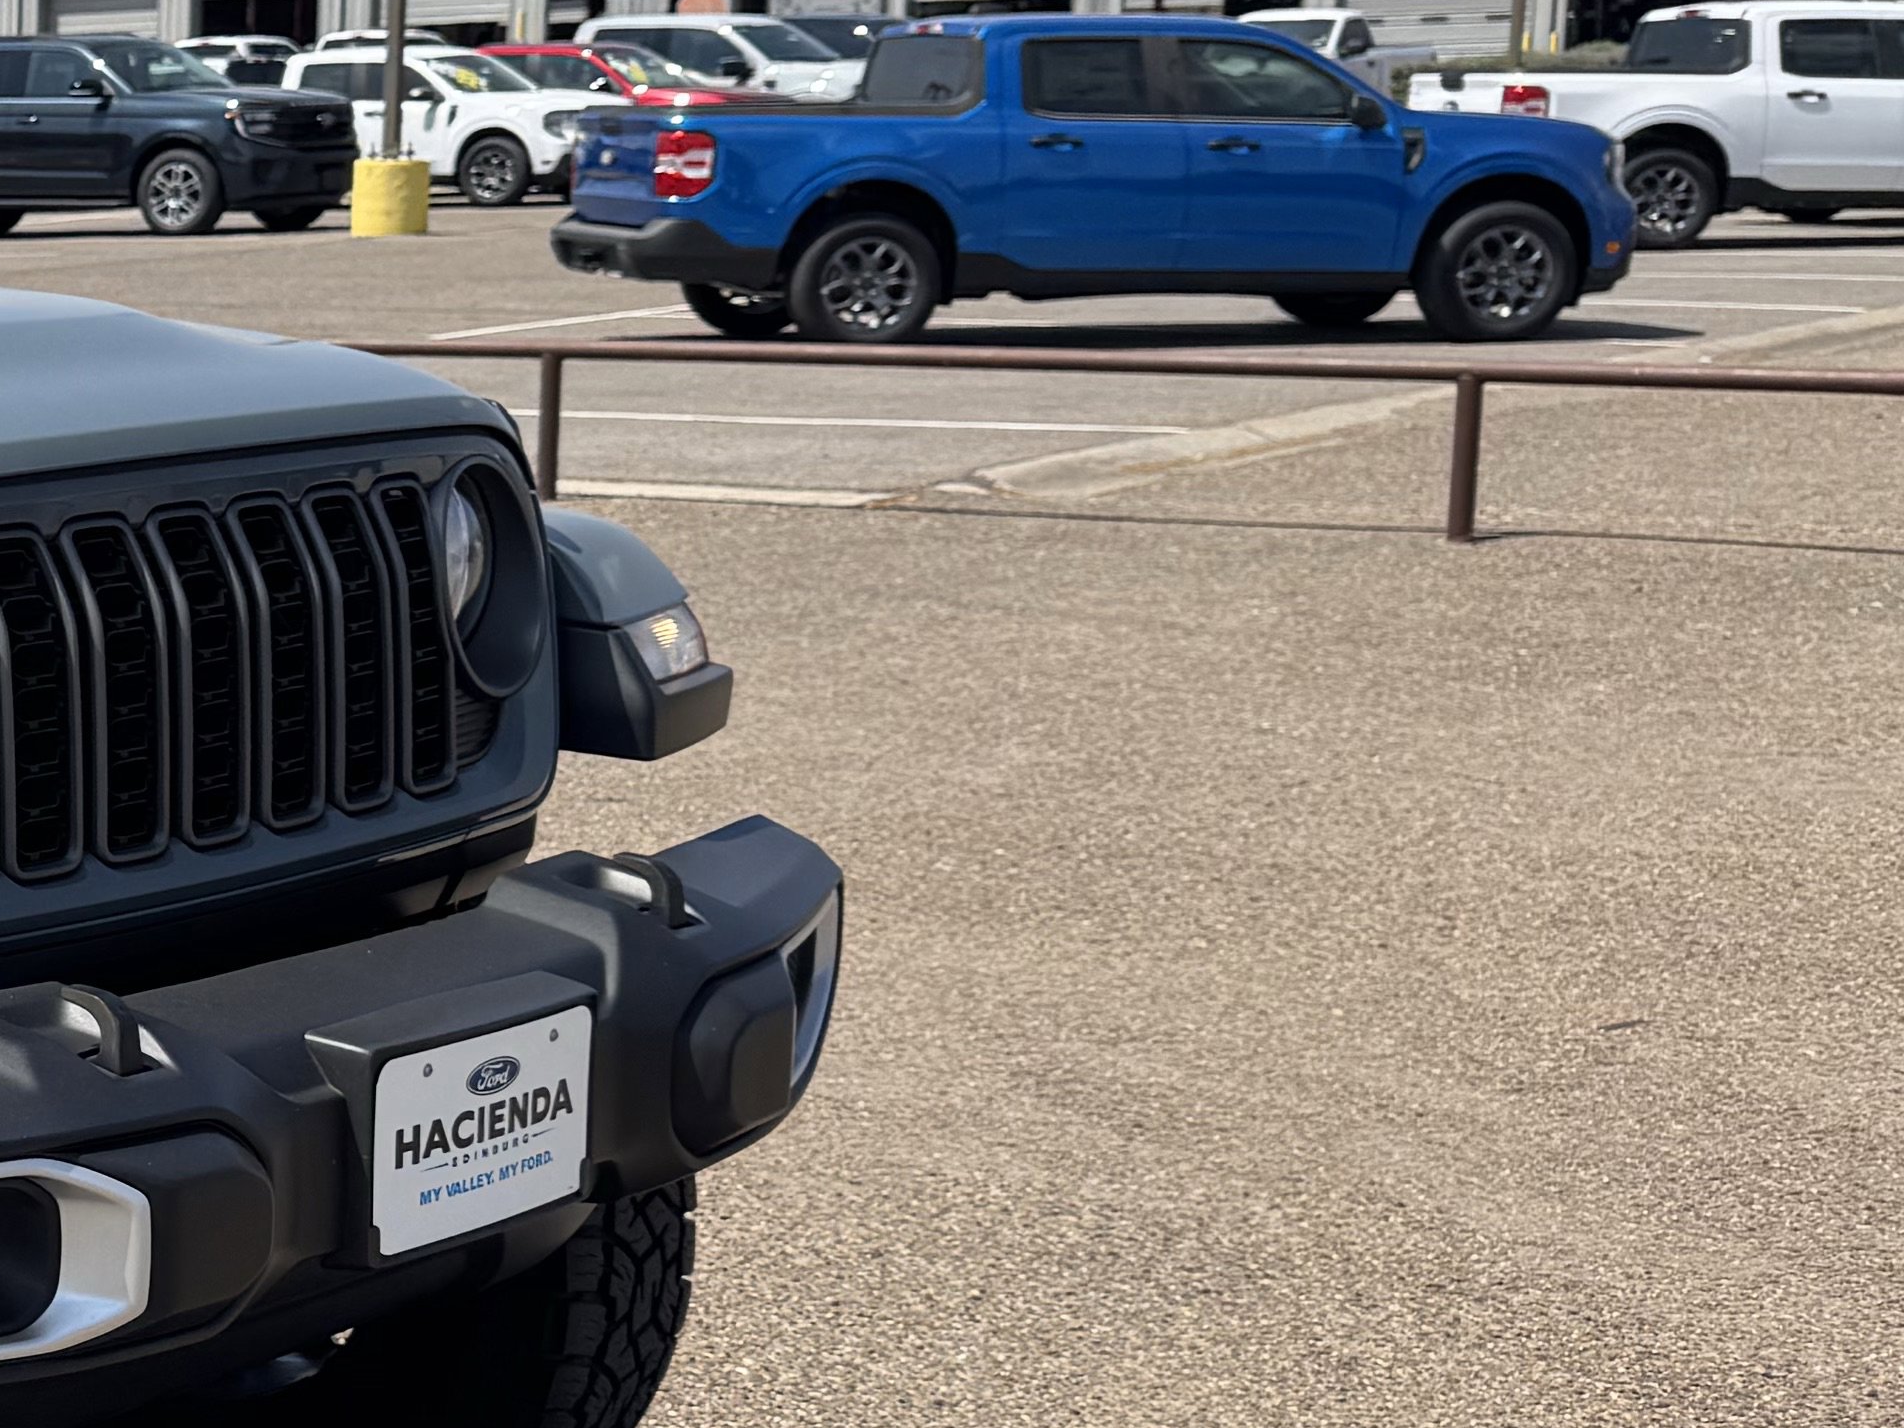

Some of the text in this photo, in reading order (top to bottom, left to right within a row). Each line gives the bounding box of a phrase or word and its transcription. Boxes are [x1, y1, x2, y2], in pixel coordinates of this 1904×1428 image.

[394, 1078, 574, 1170] HACIENDA
[452, 1134, 530, 1168] EDINBURG
[419, 1186, 443, 1207] MY
[499, 1162, 520, 1182] MY
